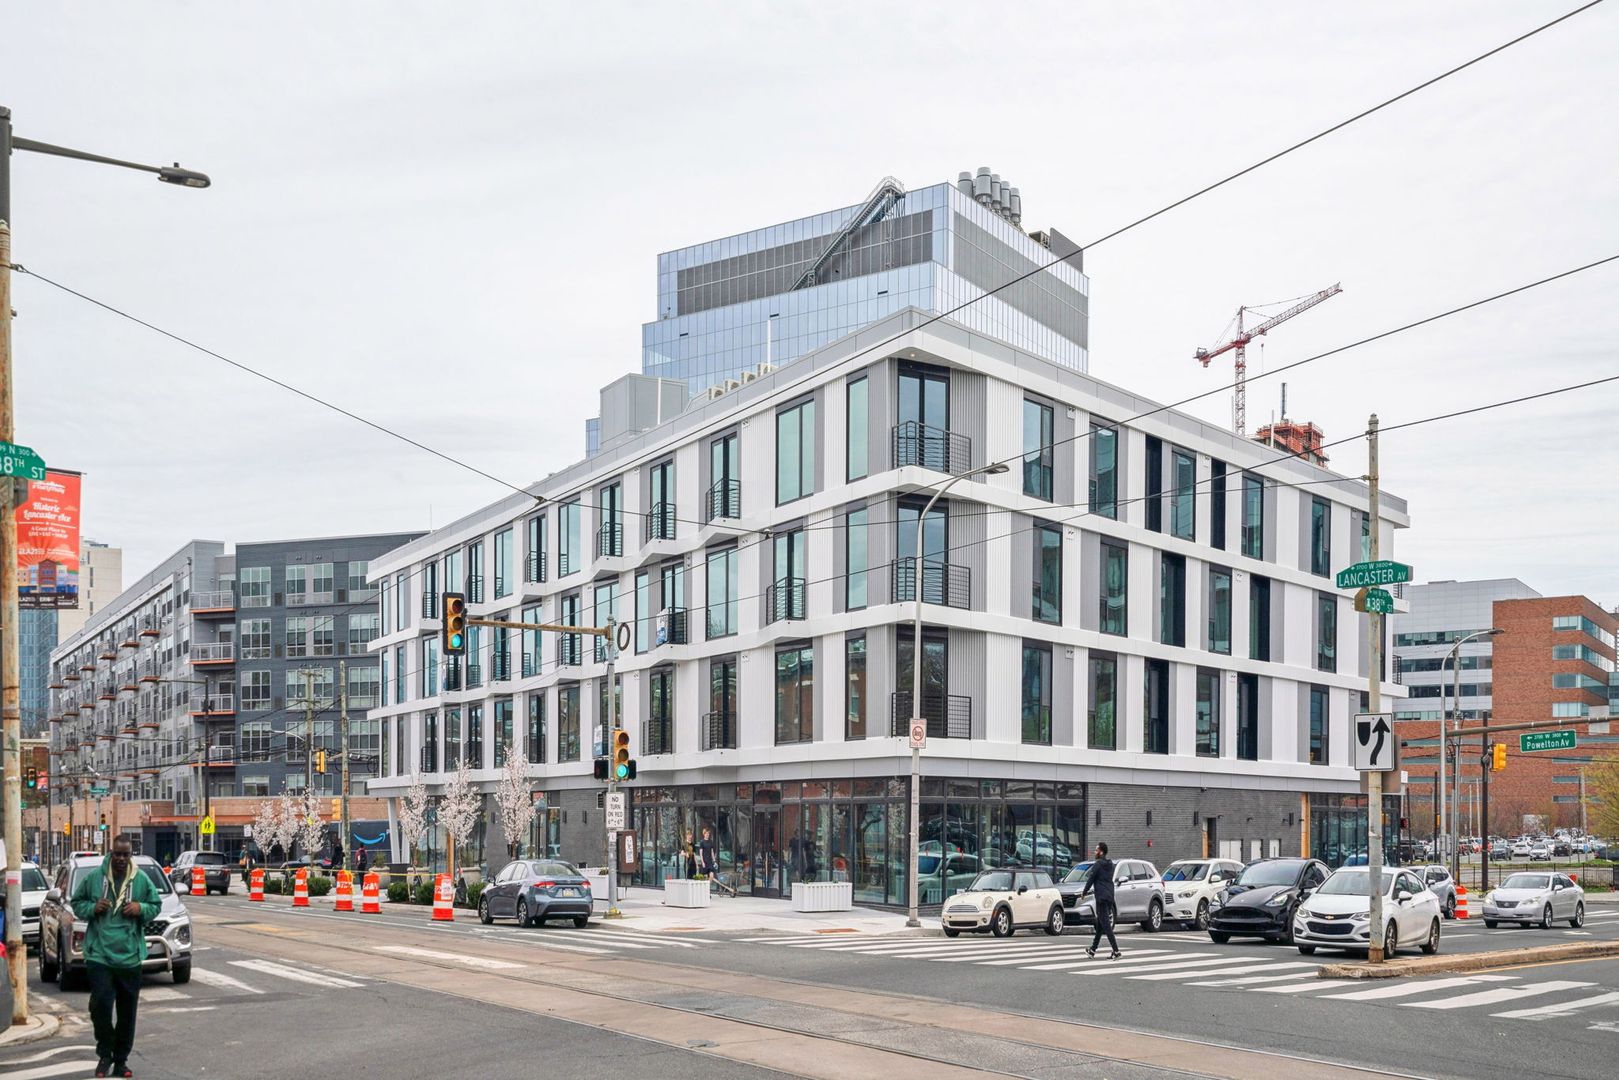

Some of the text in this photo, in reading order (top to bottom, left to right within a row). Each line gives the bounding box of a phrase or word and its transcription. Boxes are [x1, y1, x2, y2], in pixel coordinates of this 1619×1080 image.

[0, 456, 44, 479] 8TH ST
[1338, 569, 1406, 586] LANCASTER AV
[1527, 741, 1560, 749] Powelton
